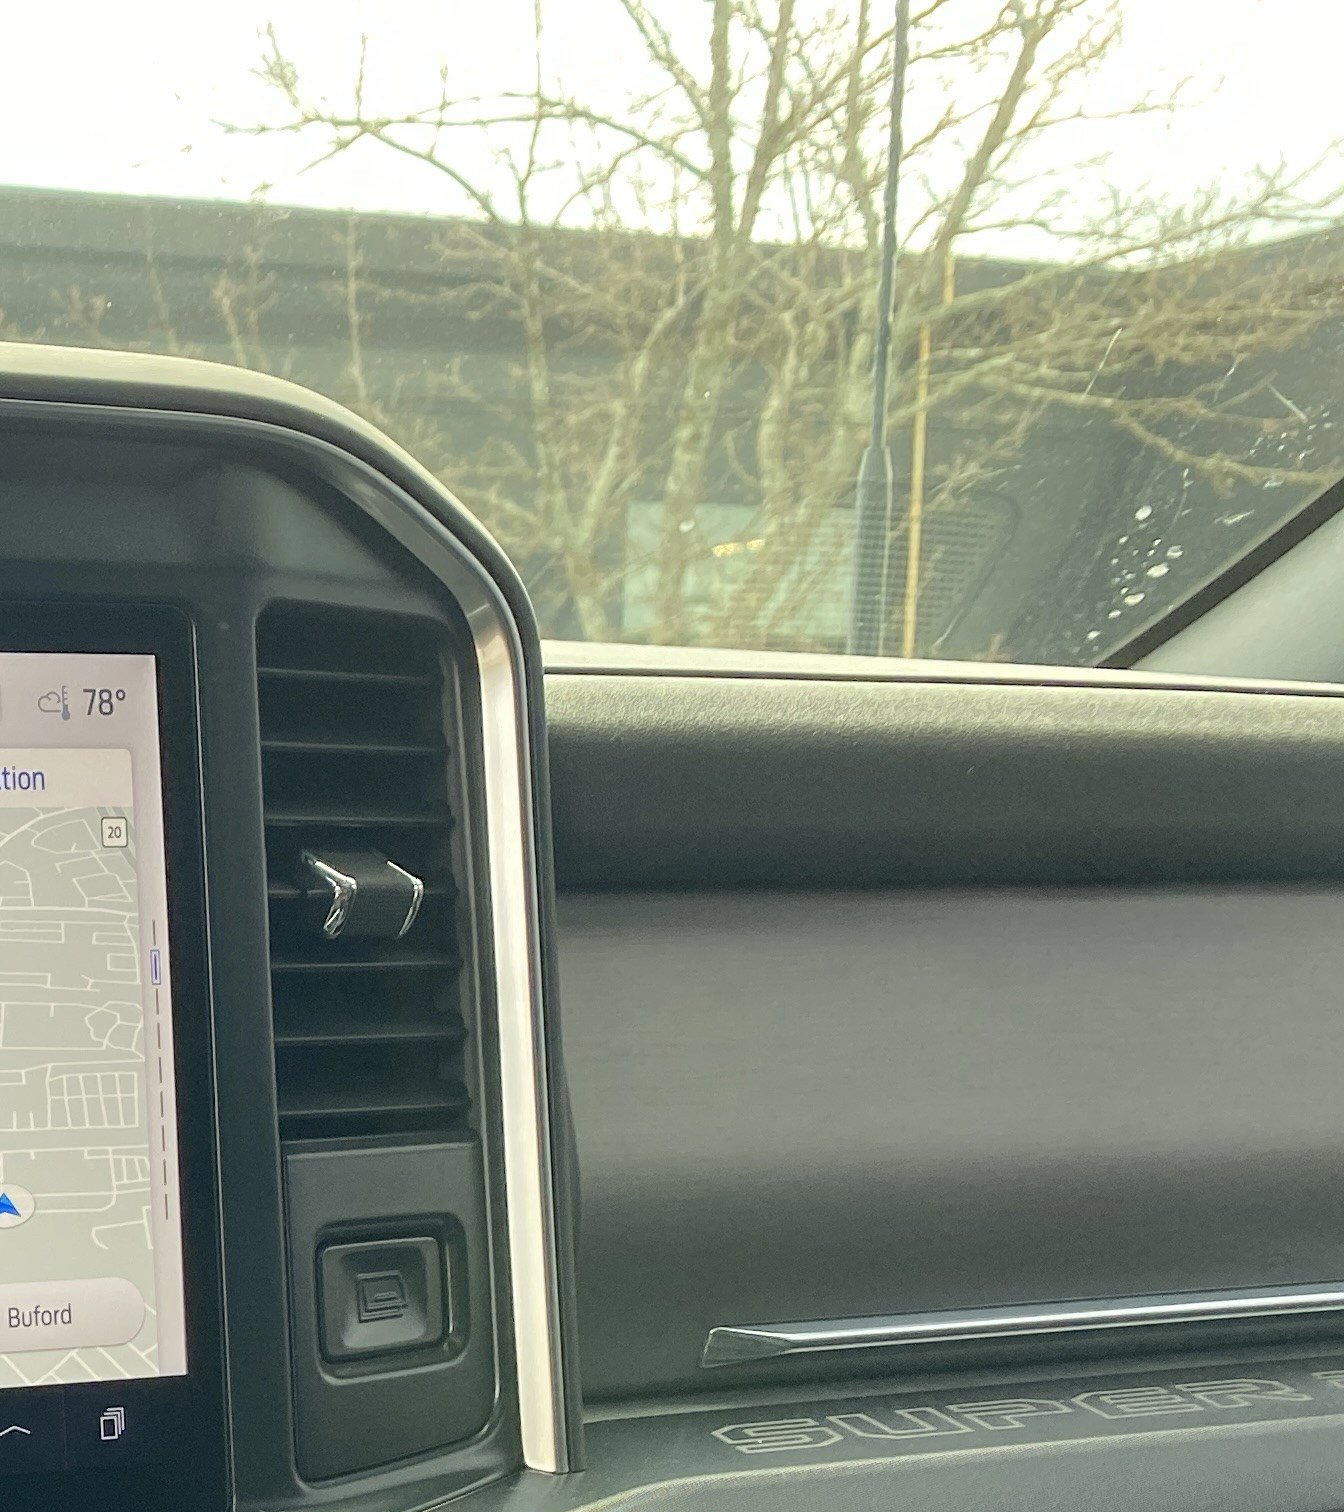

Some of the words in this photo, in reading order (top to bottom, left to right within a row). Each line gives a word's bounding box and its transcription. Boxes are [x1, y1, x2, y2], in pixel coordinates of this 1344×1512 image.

[81, 687, 127, 717] 78°
[107, 825, 121, 840] 20
[7, 1304, 73, 1328] Buford
[711, 1378, 1314, 1454] SUPER
